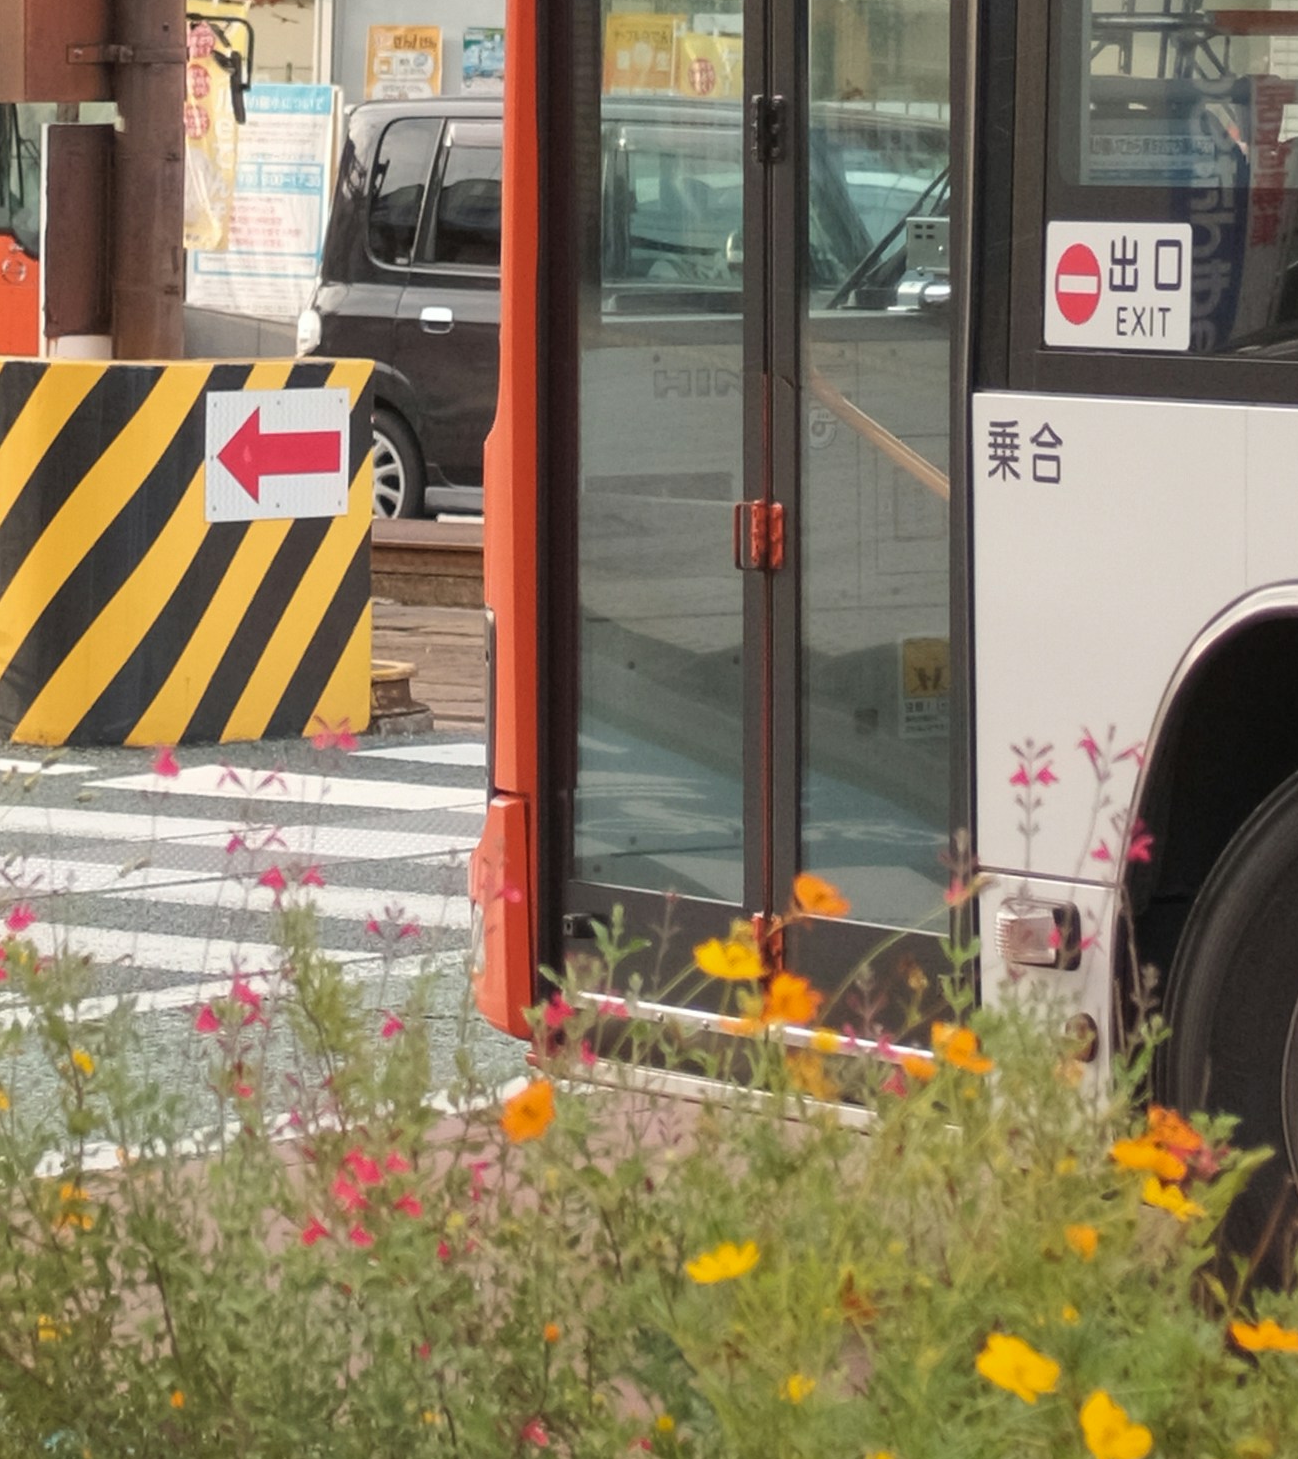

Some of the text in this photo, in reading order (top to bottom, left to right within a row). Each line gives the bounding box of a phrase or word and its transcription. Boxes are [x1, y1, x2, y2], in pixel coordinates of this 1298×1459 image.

[1109, 234, 1184, 294] 出口
[1115, 306, 1172, 338] EXIT
[987, 421, 1064, 485] 乗合
